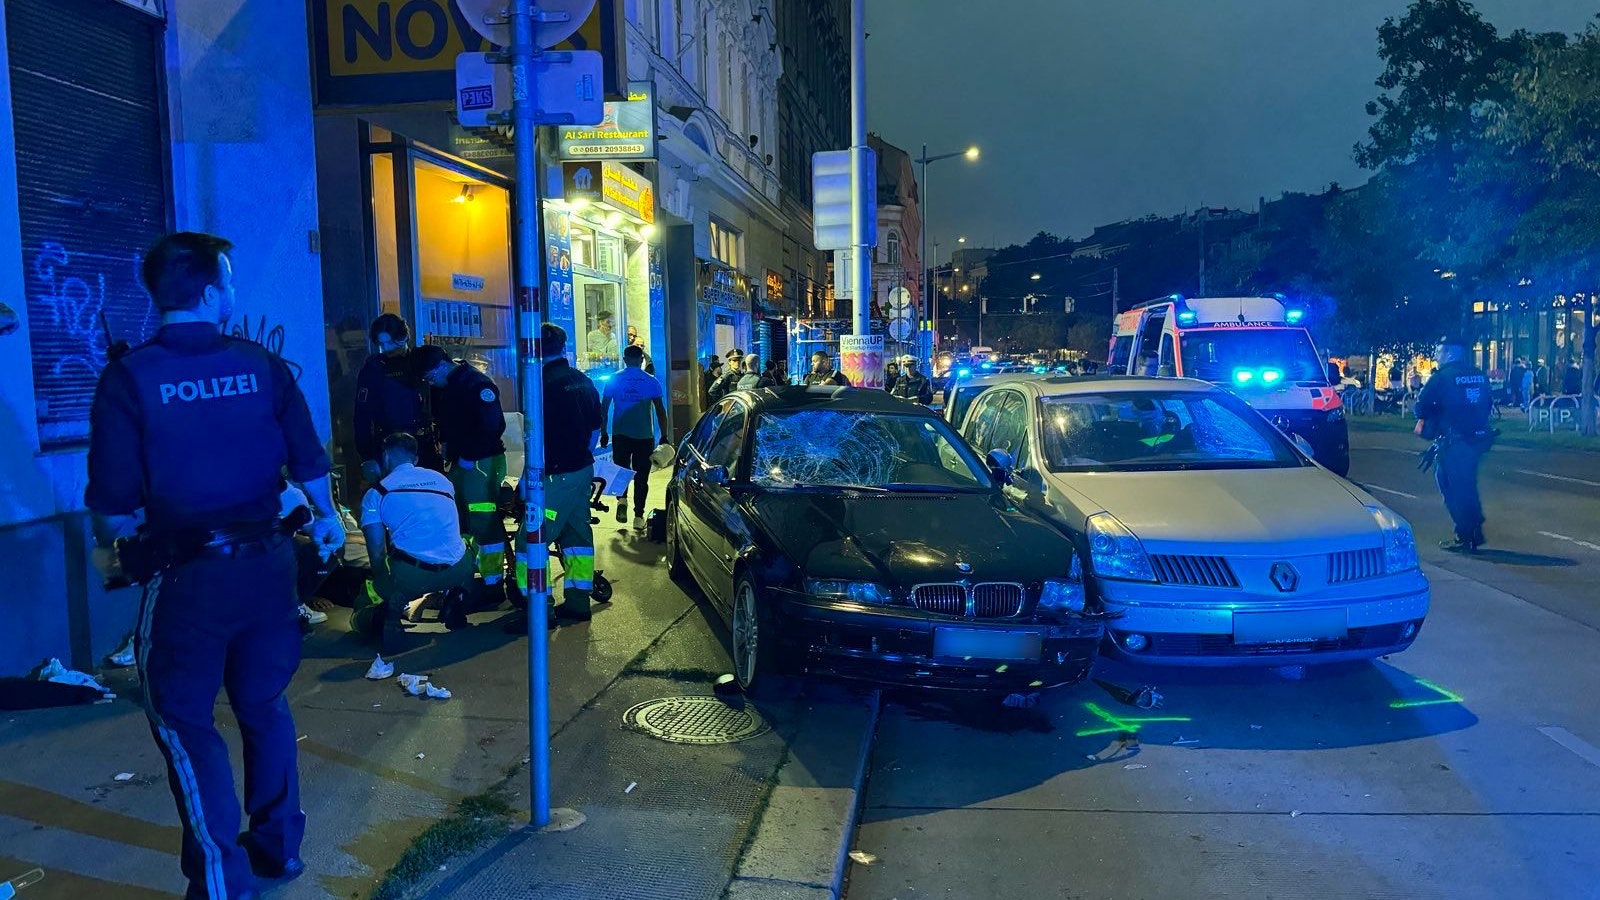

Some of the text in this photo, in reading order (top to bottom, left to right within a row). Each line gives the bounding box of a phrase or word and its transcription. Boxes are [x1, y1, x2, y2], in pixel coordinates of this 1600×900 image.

[564, 130, 649, 139] Al Sari Restaurant
[605, 145, 641, 153] 20938843
[842, 336, 883, 345] ViennaUP
[1455, 375, 1485, 385] POLIZEI
[159, 374, 258, 404] POLIZEI
